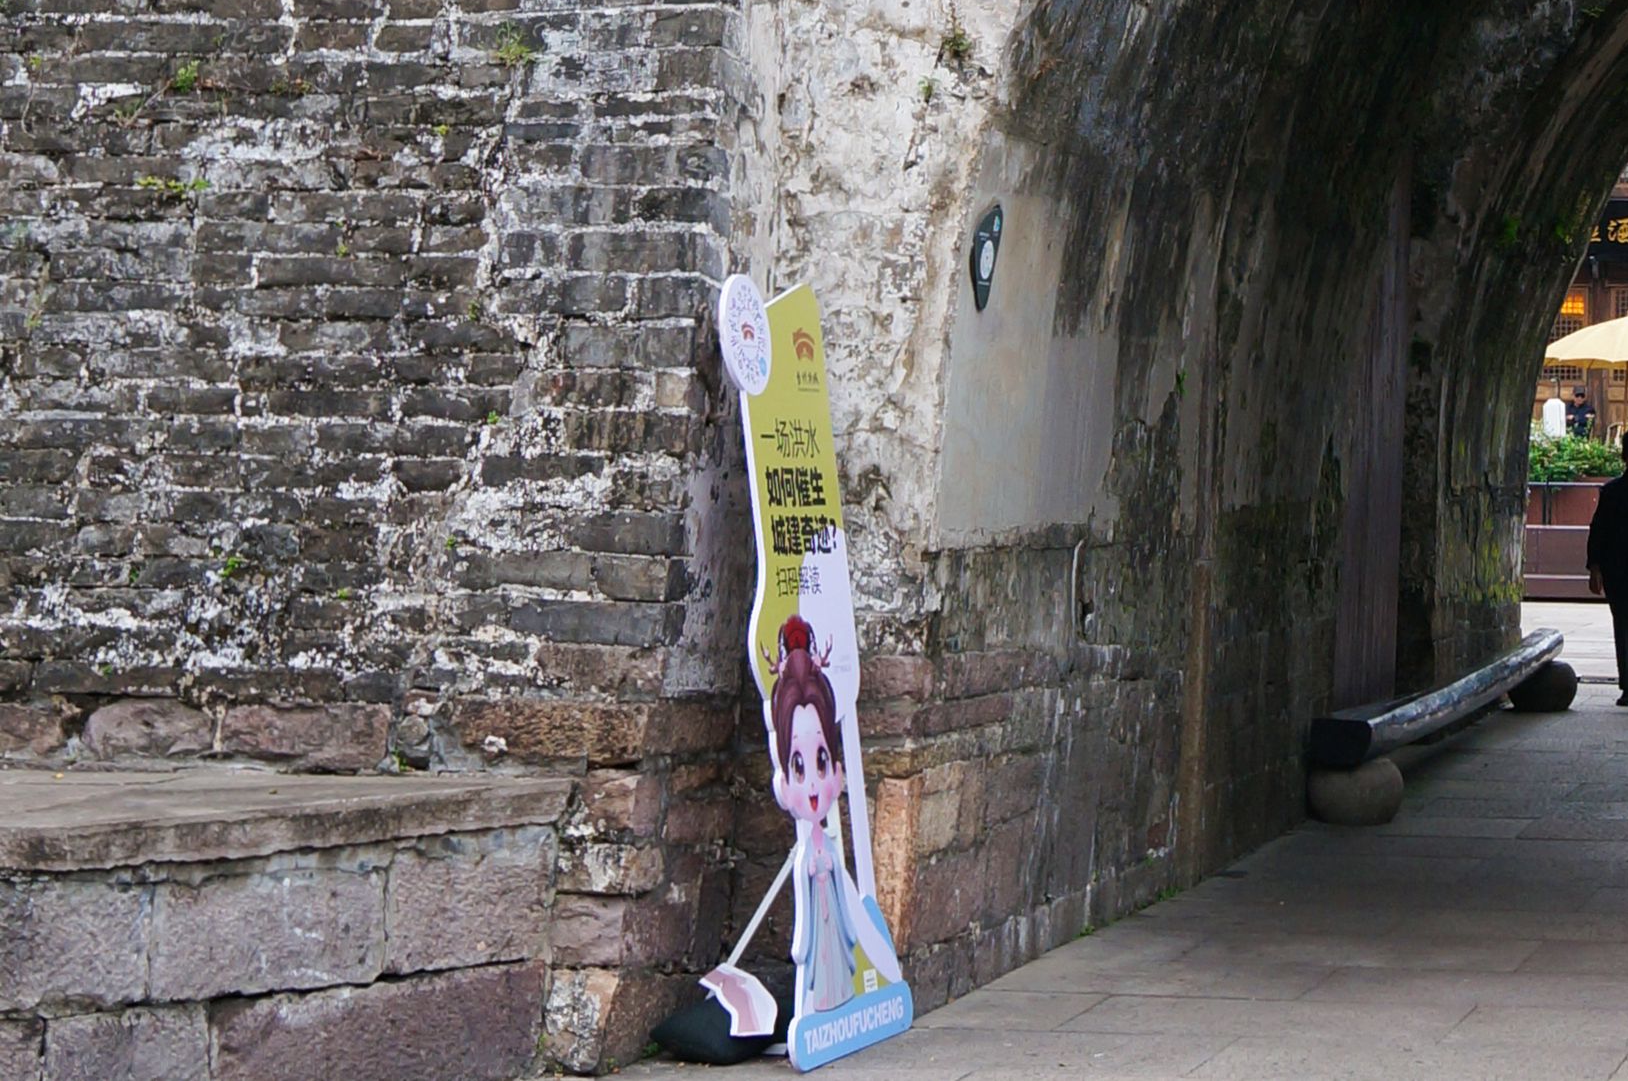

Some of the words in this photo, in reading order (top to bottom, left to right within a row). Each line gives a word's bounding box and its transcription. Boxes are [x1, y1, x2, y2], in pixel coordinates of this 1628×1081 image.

[761, 418, 820, 458] 一场洪水
[766, 466, 826, 507] 如何催生
[804, 996, 904, 1055] TAIZHOUFUCHENG
